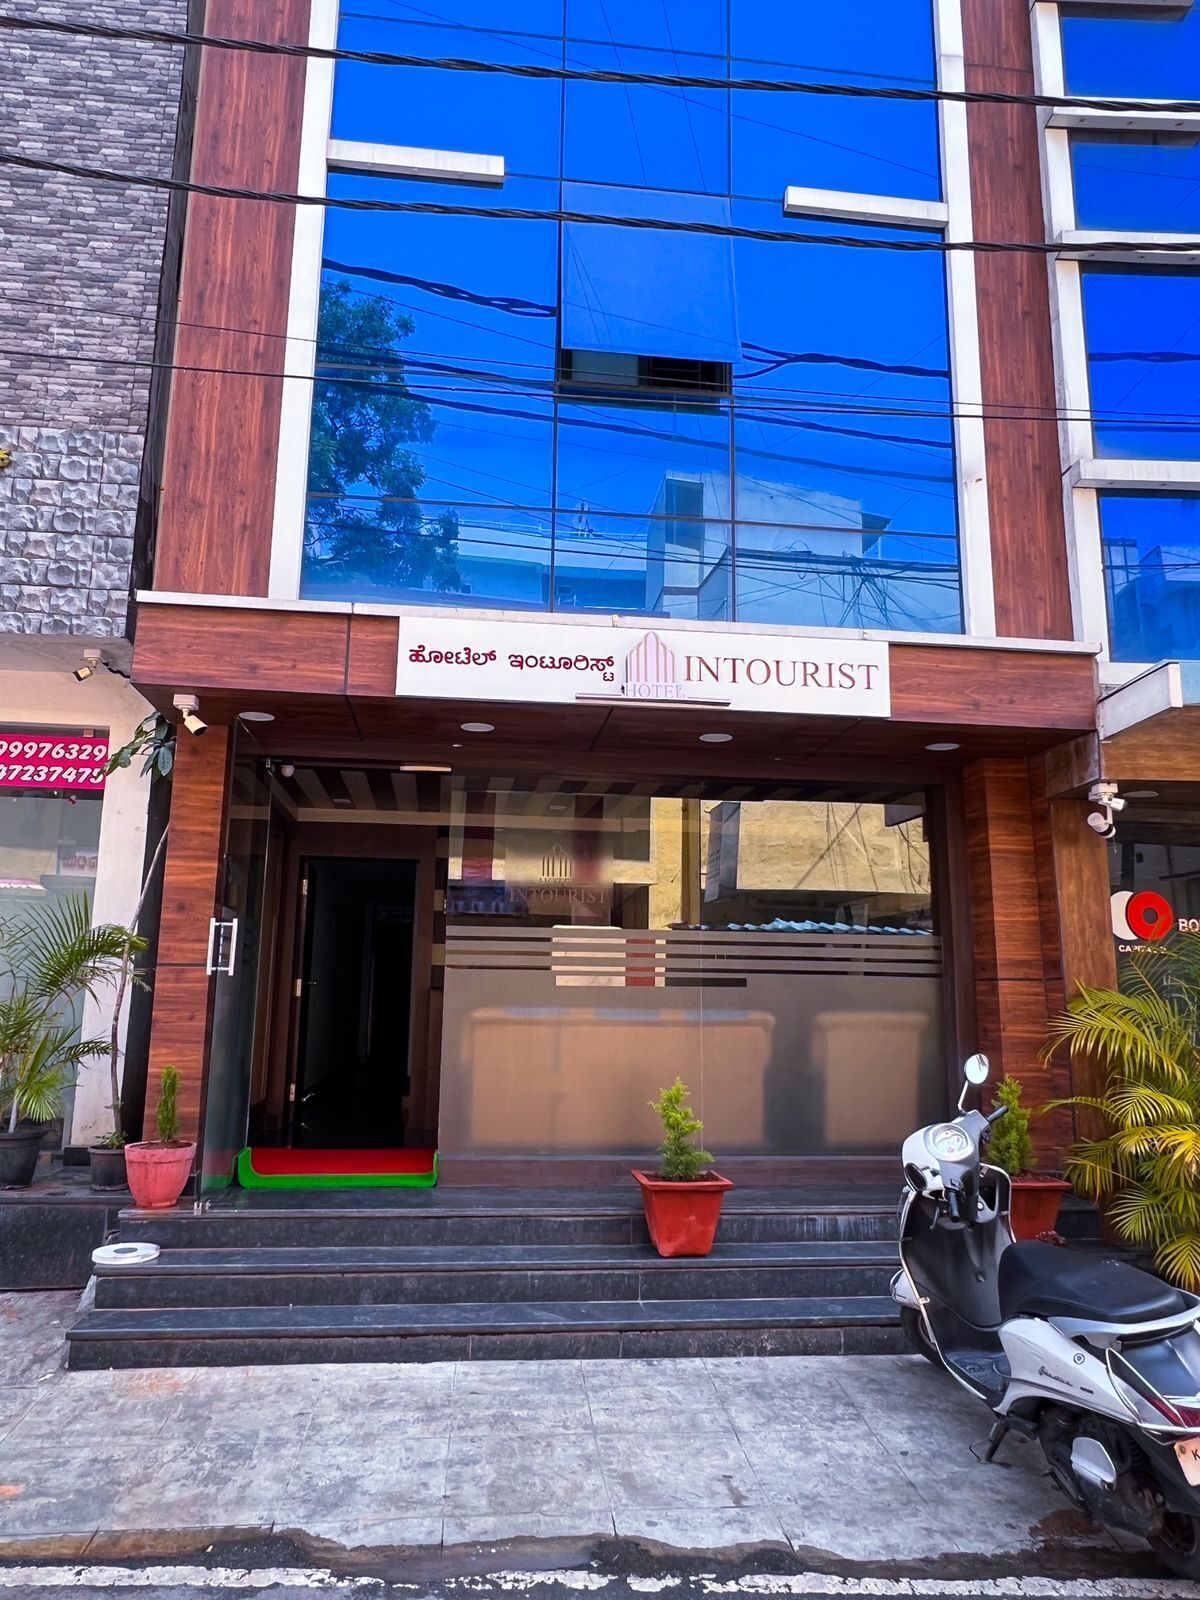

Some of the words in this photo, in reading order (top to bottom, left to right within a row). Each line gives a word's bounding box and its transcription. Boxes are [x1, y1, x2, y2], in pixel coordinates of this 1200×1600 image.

[409, 644, 497, 666] ಹೋಟೆಲ್
[684, 655, 879, 690] INTOURIST
[625, 683, 686, 699] HOTEL
[509, 887, 605, 904] INTOURIST
